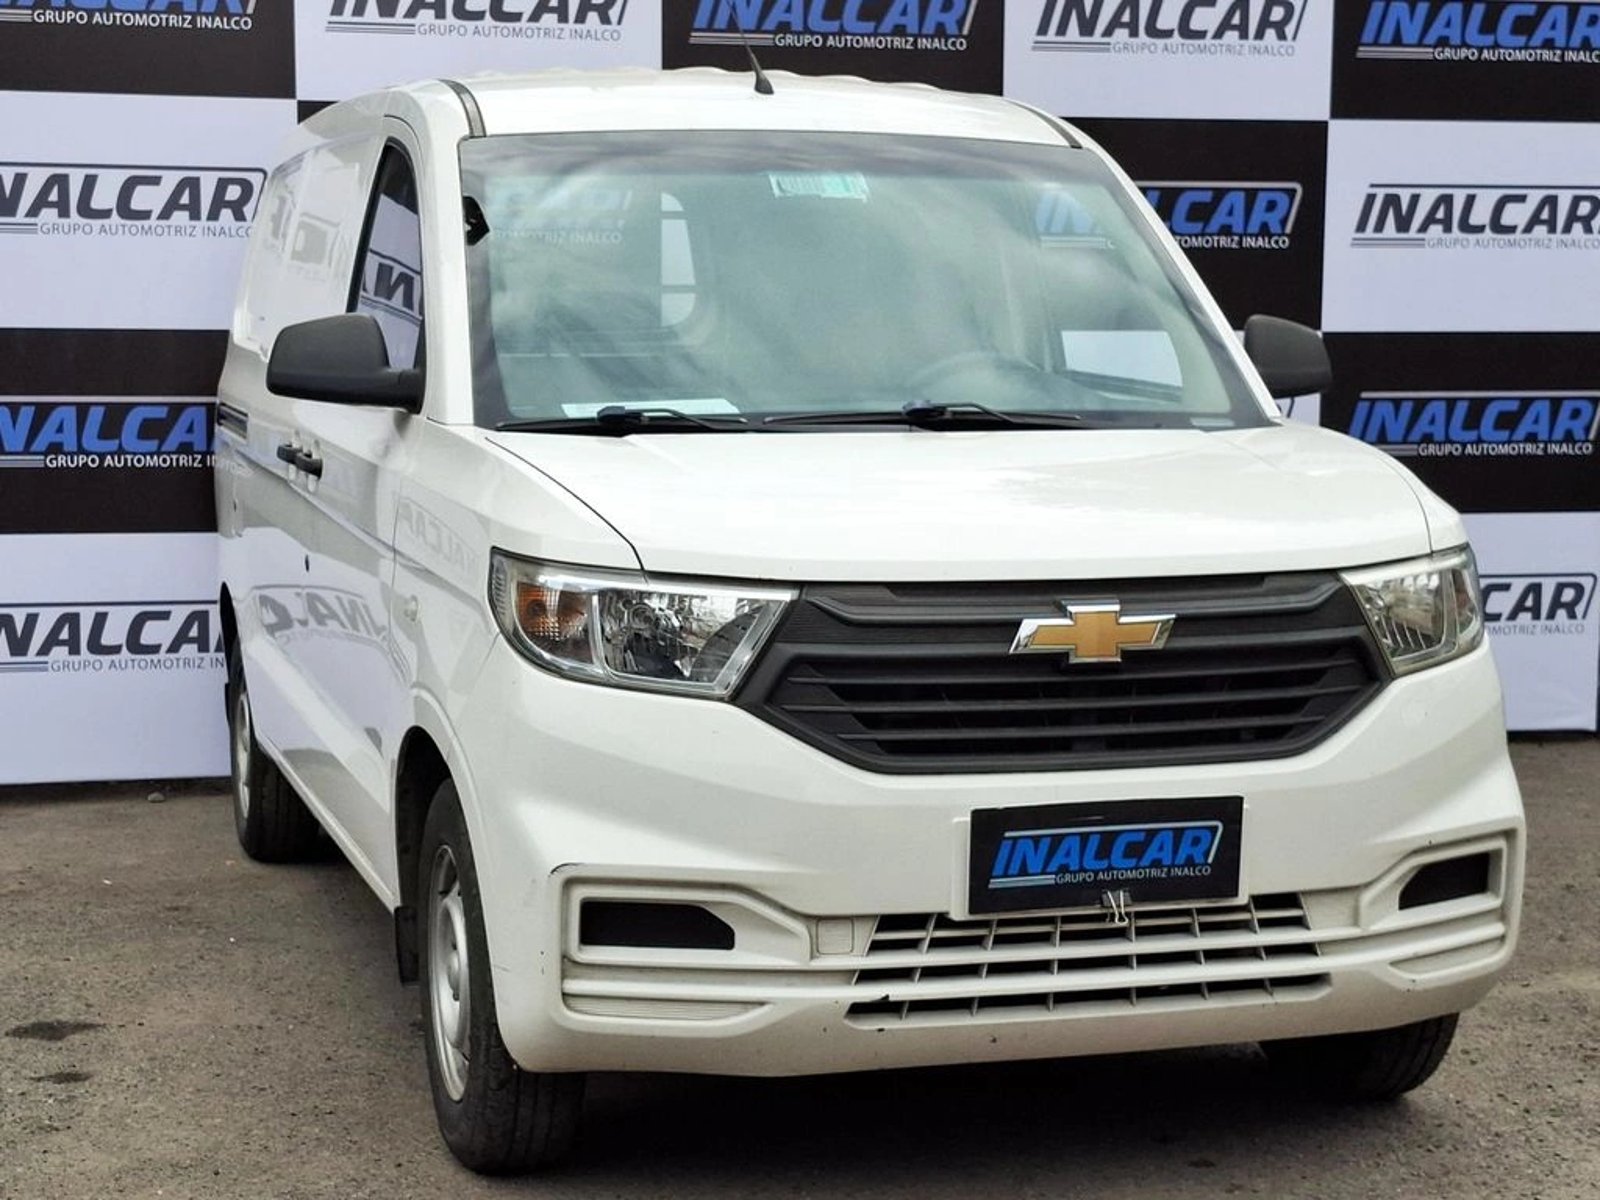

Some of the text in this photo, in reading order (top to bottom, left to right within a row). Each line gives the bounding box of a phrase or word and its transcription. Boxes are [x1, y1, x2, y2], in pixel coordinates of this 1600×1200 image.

[33, 9, 253, 30] GRUPO AUTOMOTRIZ INALCO
[1036, 0, 1294, 41] INALCAR
[1360, 2, 1600, 48] INALCAR
[417, 23, 621, 41] GRUPO AUTOMOTRIZ INALCO
[774, 34, 967, 51] GRUPO AUTOMOTRIZ INALCO
[1112, 42, 1295, 57] GRUPO AUTOMOTRIZ INALCO
[1434, 48, 1478, 61] GRUPO
[1481, 49, 1562, 63] AUTOMOTRIZ
[1354, 193, 1600, 234] INALCAR
[40, 222, 93, 236] GRUPO
[99, 223, 197, 238] AUTOMOTRIZ
[1242, 236, 1289, 249] INALCO
[1427, 237, 1471, 249] GRUPO
[1474, 237, 1552, 250] AUTOMOTRIZ
[1350, 400, 1593, 442] INALCAR
[1418, 441, 1593, 456] GRUPO AUTOMOTRIZ INALCO
[46, 454, 99, 468] GRUPO
[104, 454, 202, 467] AUTOMOTRIZ
[0, 610, 224, 657] NALCA
[50, 659, 103, 673] GRUPO
[108, 657, 205, 671] AUTOMOTRIZ
[992, 828, 1212, 877] INALCAR
[1056, 865, 1211, 884] GRUPO AUTOMOTRIZ INALCO
